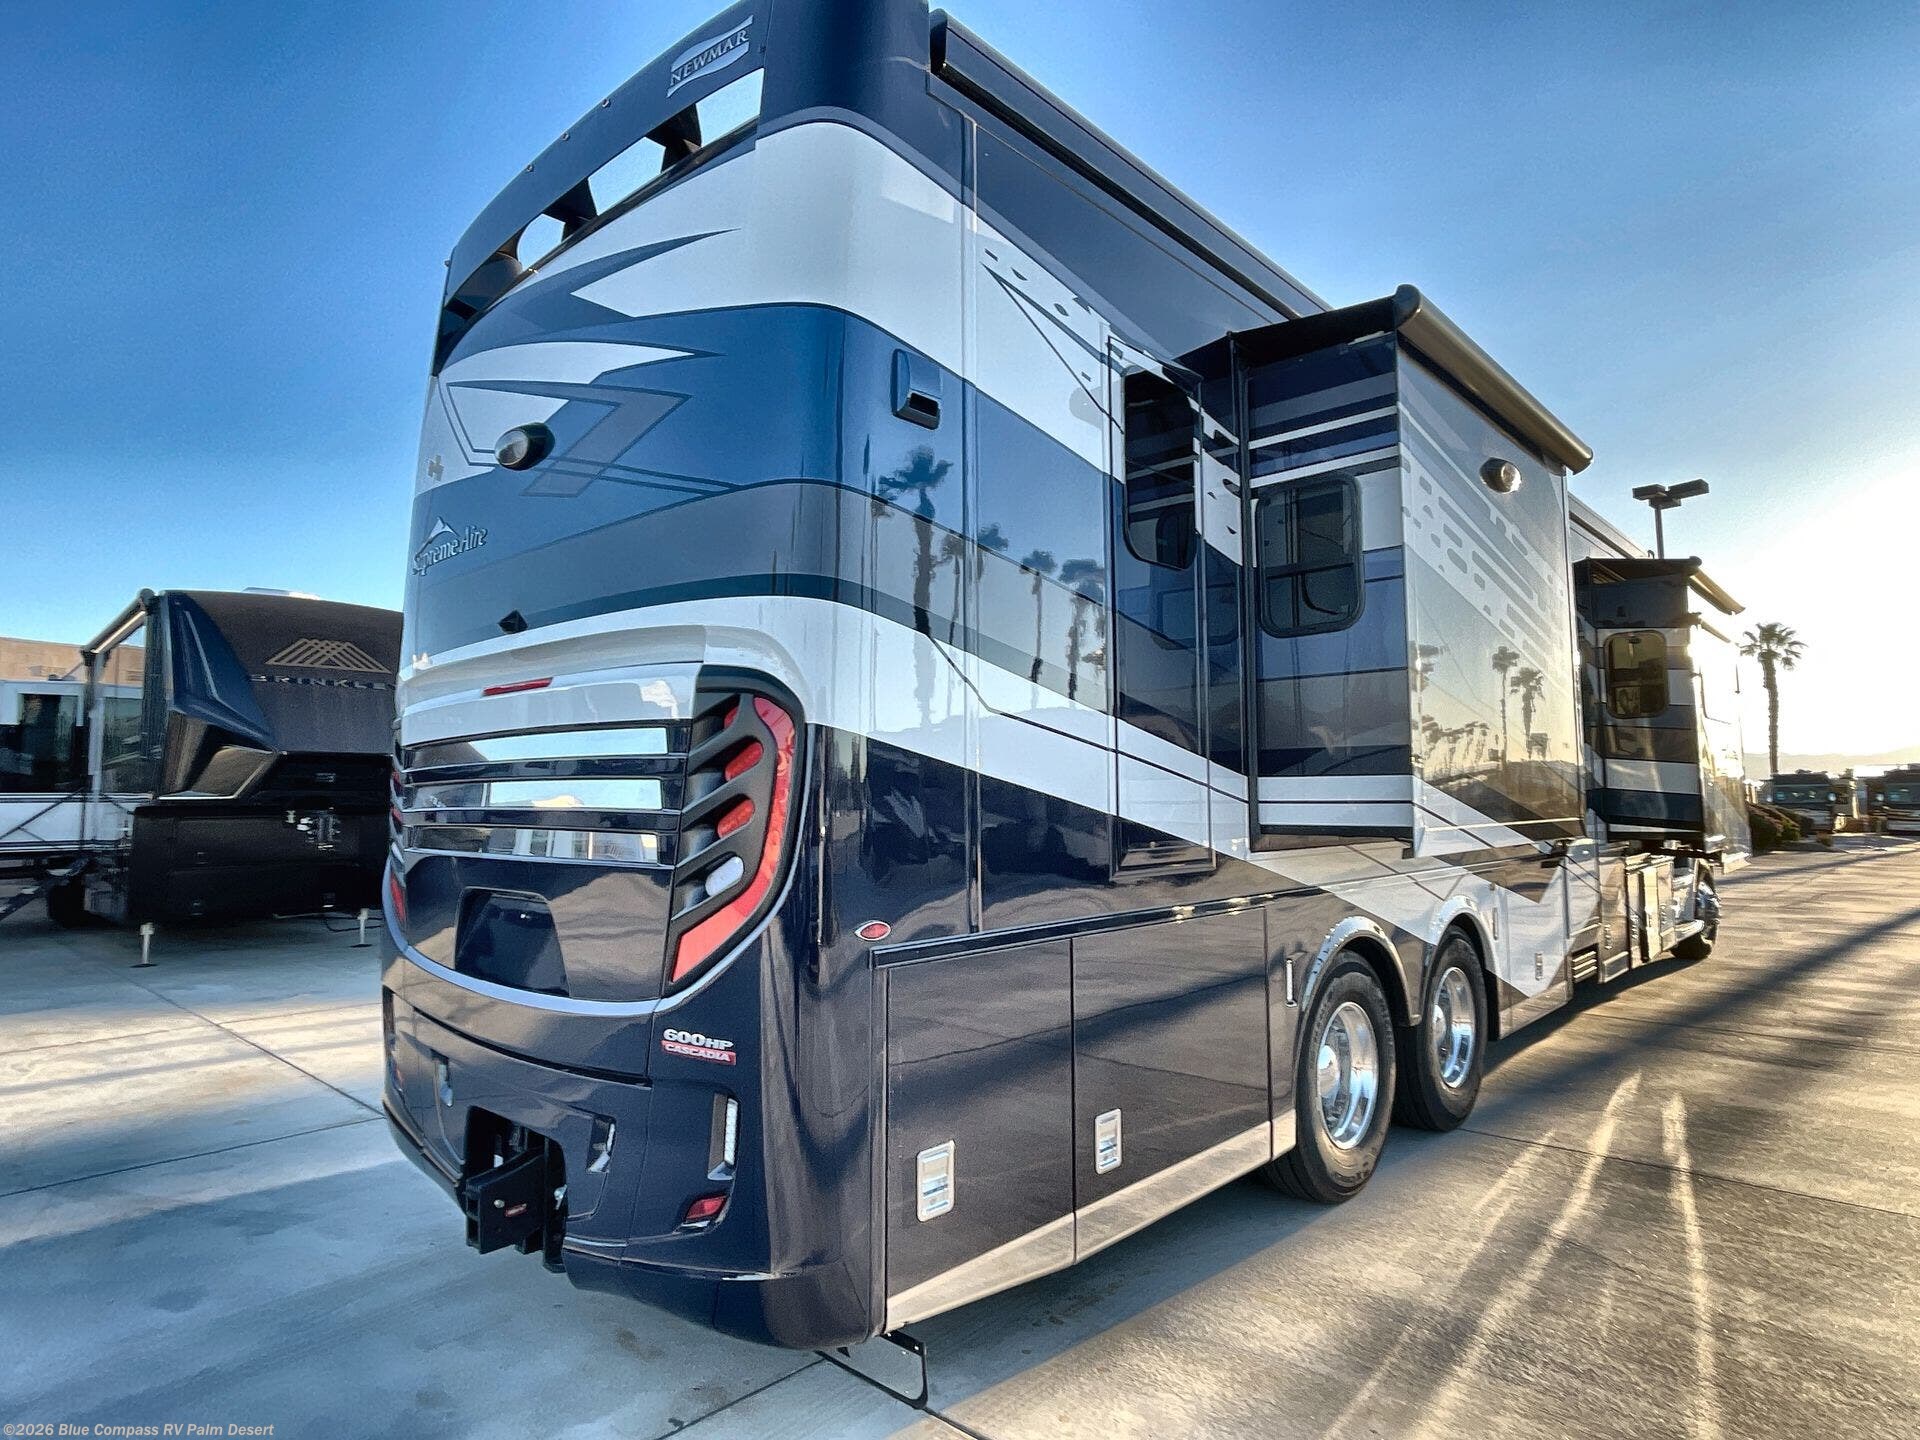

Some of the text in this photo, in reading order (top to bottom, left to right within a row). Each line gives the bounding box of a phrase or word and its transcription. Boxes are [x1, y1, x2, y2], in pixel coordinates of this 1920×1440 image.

[670, 29, 750, 86] NEWMAR
[412, 525, 488, 576] Supreme Aire
[663, 1028, 734, 1050] 600HP
[665, 1043, 731, 1062] CASCADIA
